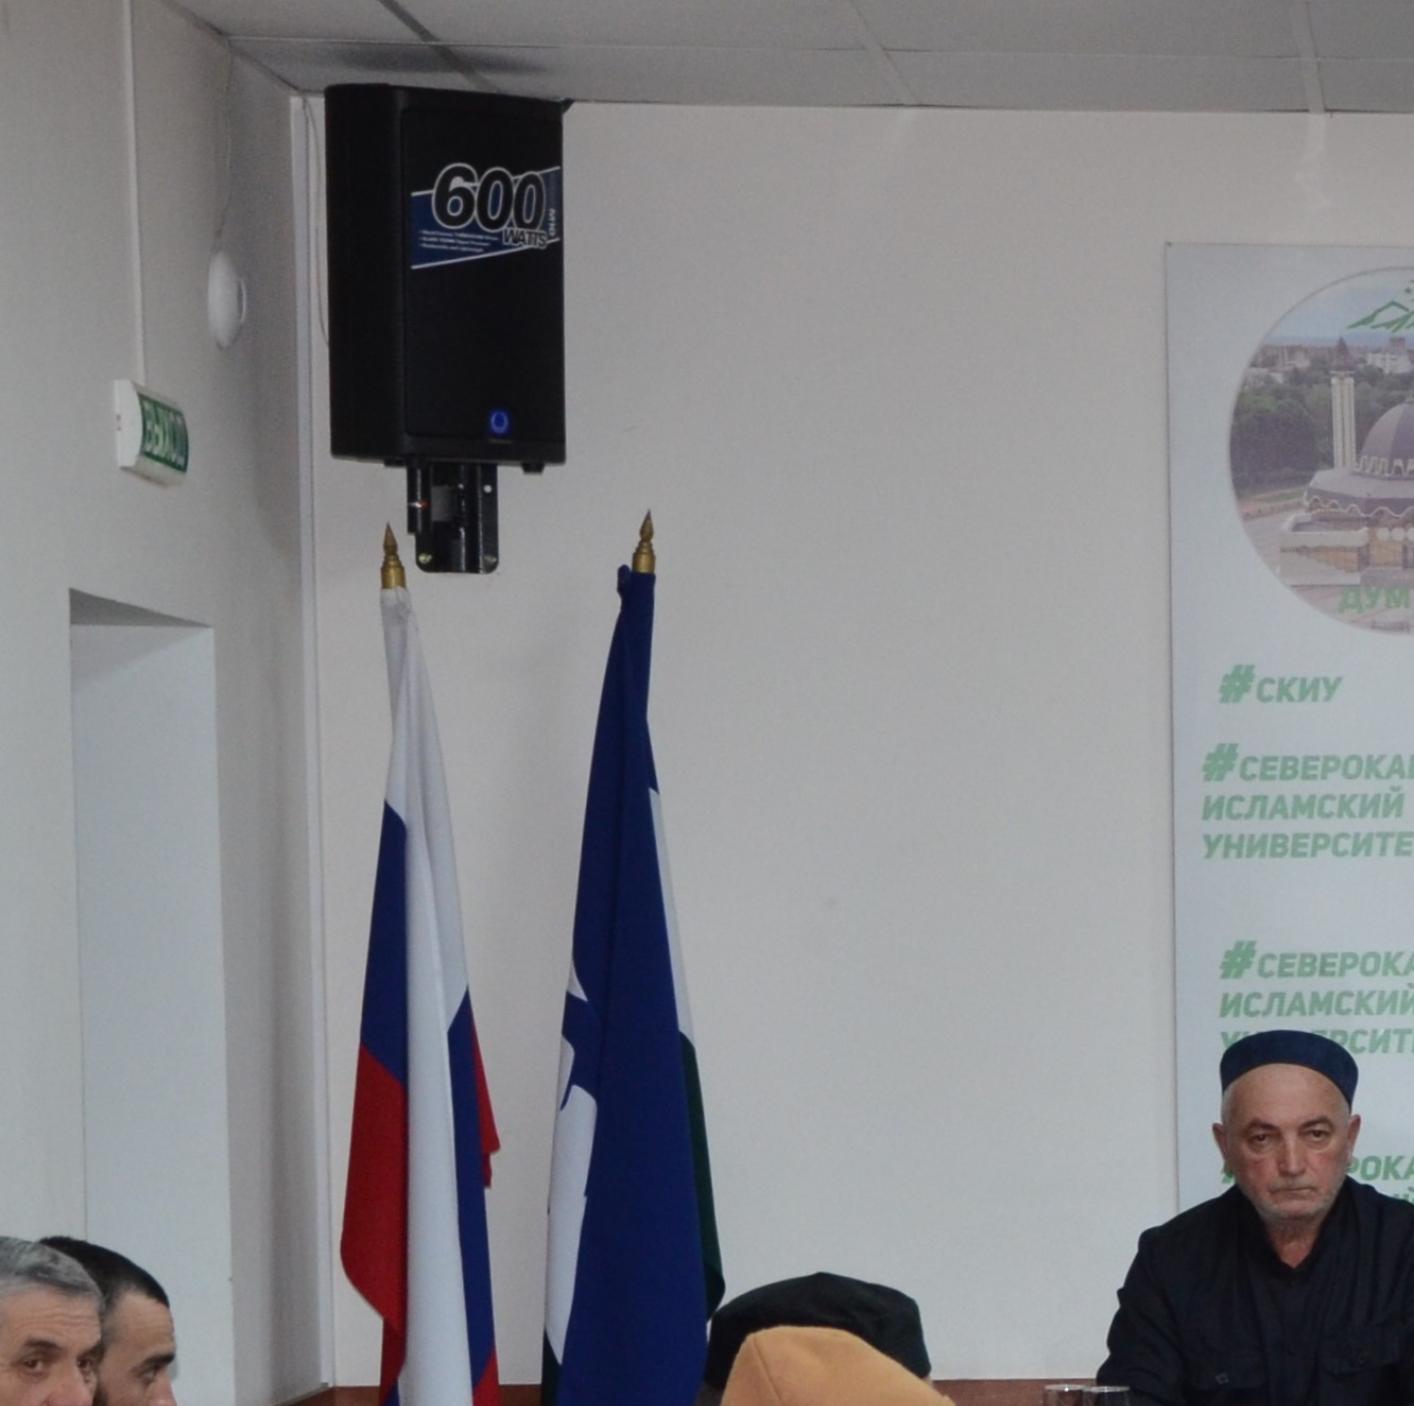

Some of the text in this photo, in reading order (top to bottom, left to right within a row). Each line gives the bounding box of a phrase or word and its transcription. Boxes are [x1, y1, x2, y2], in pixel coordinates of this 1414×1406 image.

[432, 163, 545, 232] 600
[503, 228, 548, 250] WATTS
[1340, 586, 1410, 613] ДУМ
[1220, 665, 1341, 703] #СКИУ
[1202, 786, 1405, 821] ИСЛАМСКИЙ
